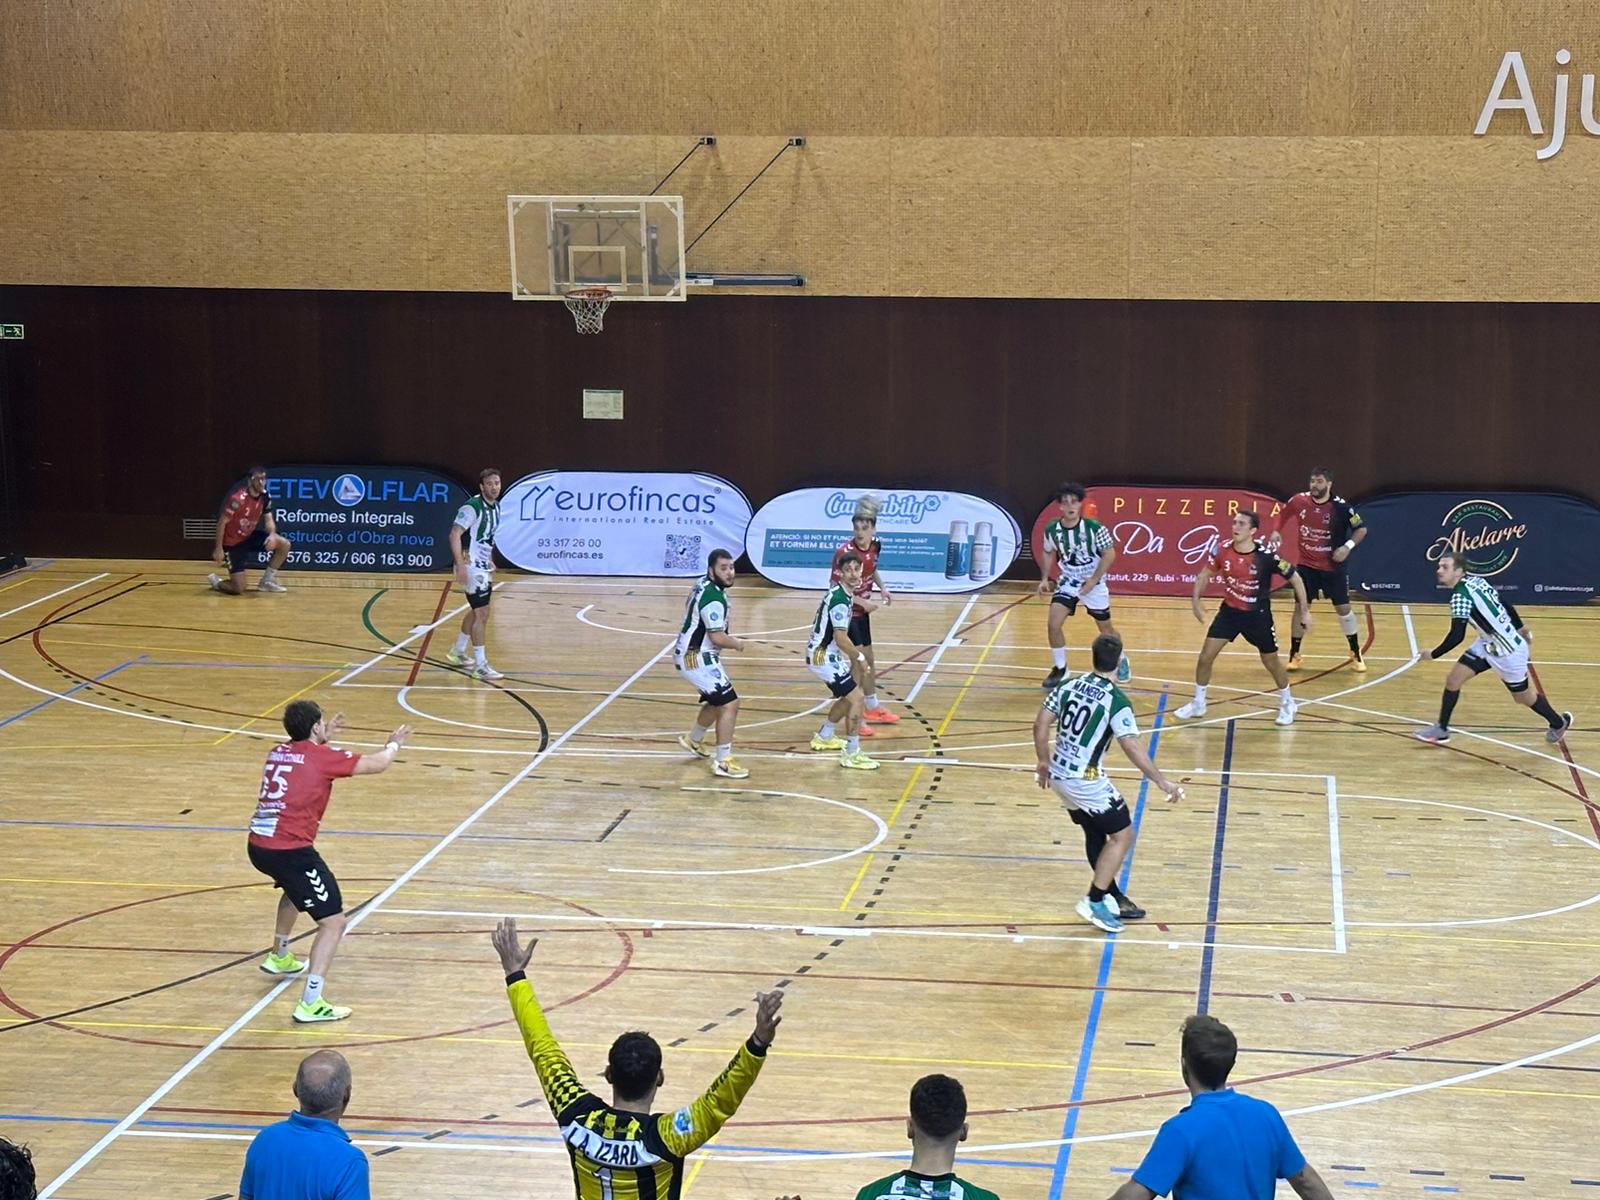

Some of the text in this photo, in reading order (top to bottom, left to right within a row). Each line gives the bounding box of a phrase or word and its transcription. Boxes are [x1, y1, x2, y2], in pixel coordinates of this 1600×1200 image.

[1114, 498, 1281, 517] PIZZERIA
[275, 508, 415, 527] Reformes Integrals
[644, 517, 669, 525] Real
[677, 517, 714, 525] Estate
[347, 531, 395, 545] d'Obra
[400, 534, 434, 546] nova
[537, 538, 551, 548] 93
[553, 538, 570, 548] 317
[588, 538, 602, 548] 00
[769, 540, 780, 548] ET
[782, 541, 817, 549] TORNEM
[1113, 521, 1165, 555] Da
[1425, 524, 1528, 562] Akelarre
[286, 551, 311, 563] 576
[315, 552, 339, 564] 325
[351, 552, 376, 565] 606
[381, 553, 404, 566] 163
[408, 554, 433, 567] 900
[536, 550, 604, 560] eurofincas.es
[1224, 560, 1231, 572] 3
[1132, 574, 1149, 582] 229
[1072, 680, 1106, 701] MANERO
[1061, 700, 1091, 735] 60
[594, 1140, 639, 1166] IZARD
[593, 1167, 612, 1200] 1
